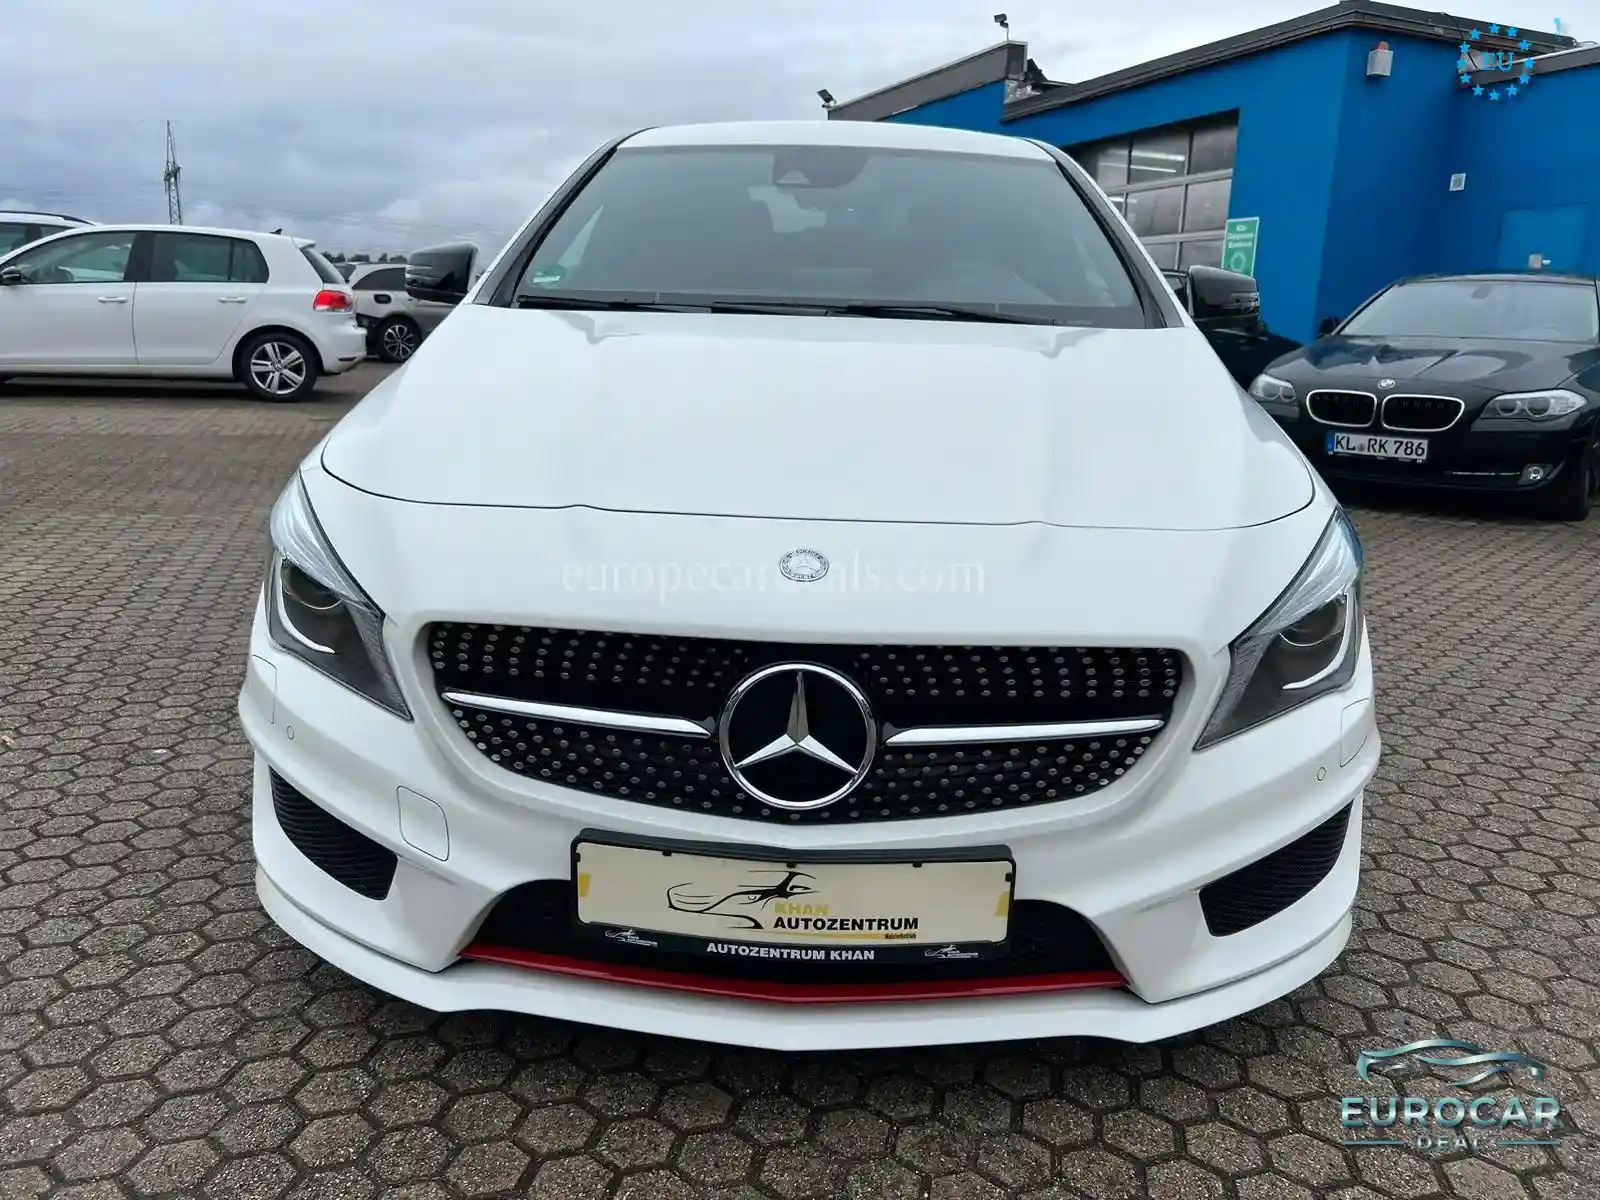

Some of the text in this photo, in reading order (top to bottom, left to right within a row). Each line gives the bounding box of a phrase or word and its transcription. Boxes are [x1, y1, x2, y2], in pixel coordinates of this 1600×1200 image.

[1335, 435, 1426, 457] KL RK 786
[774, 902, 829, 915] KHAN
[773, 916, 919, 931] AUTOZENTRUM
[706, 942, 875, 961] AUTOZENTRUM KHAN
